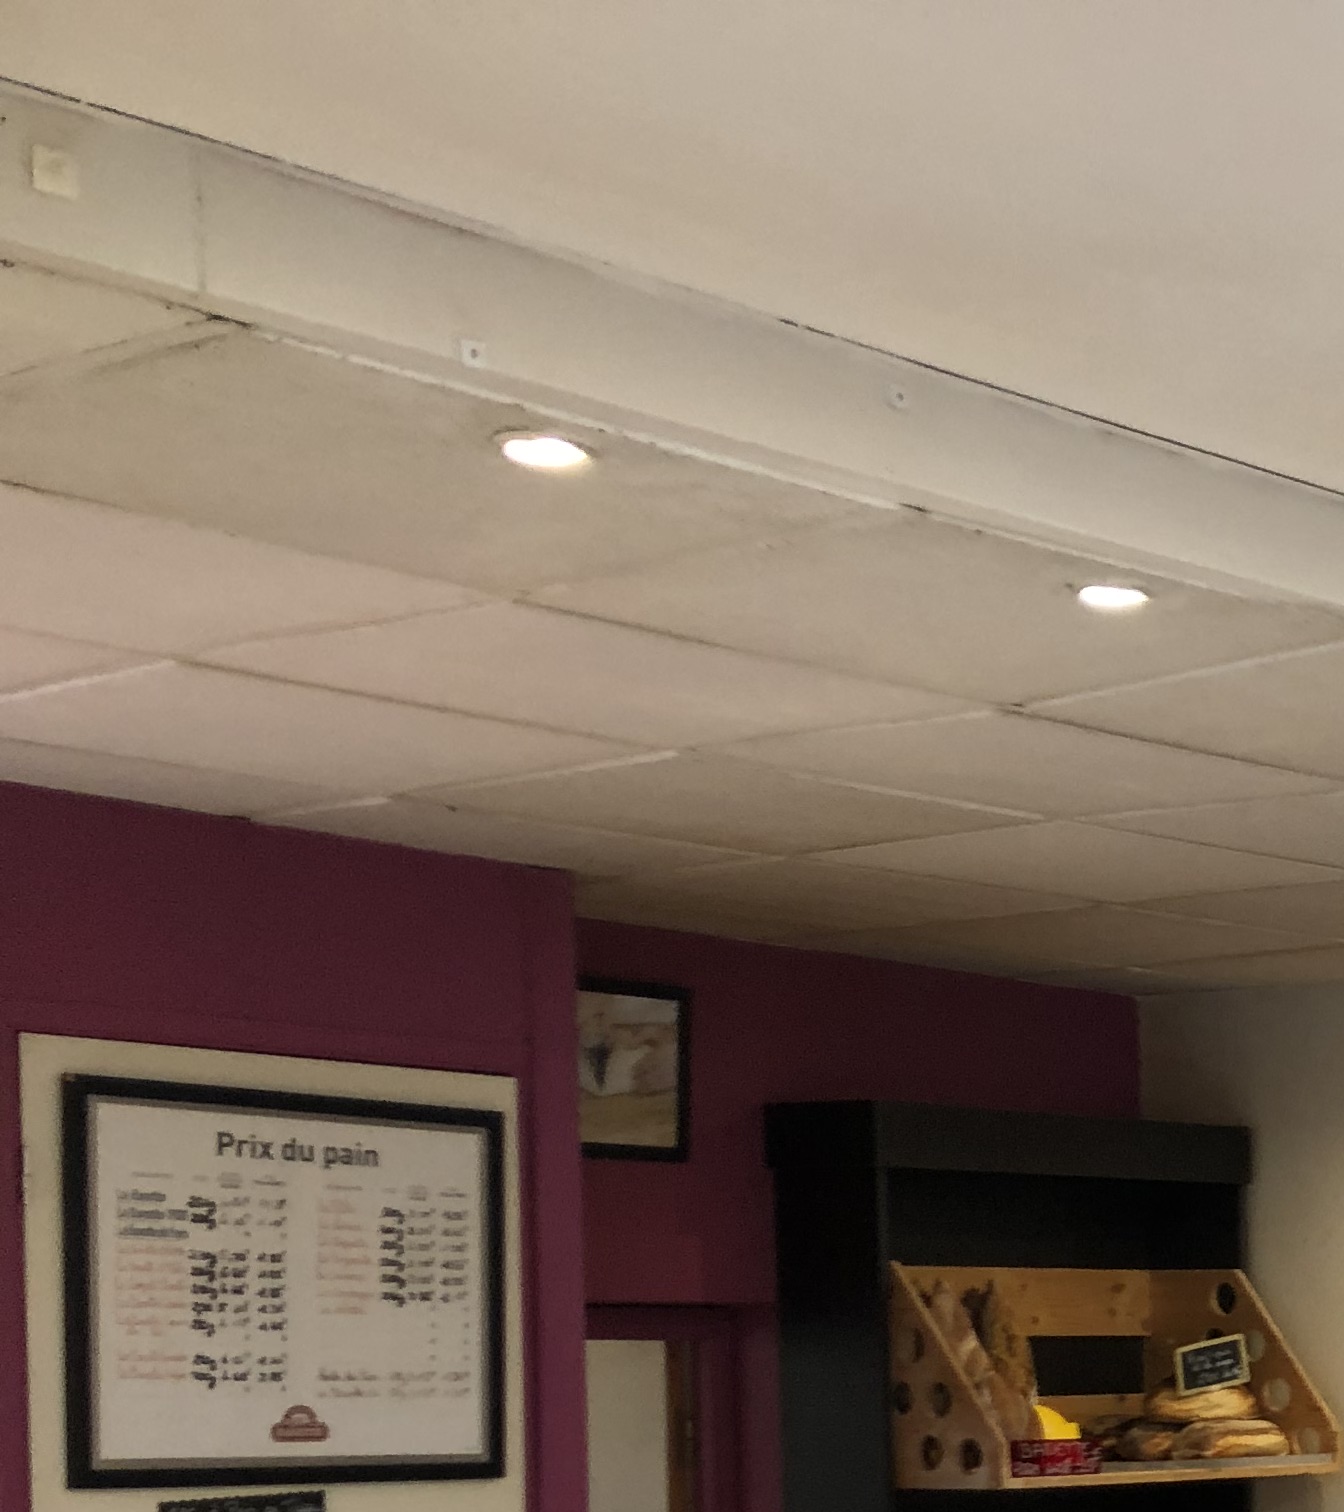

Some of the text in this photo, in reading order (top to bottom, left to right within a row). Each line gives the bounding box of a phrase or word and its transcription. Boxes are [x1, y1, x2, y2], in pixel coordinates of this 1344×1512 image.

[216, 1132, 380, 1170] Prix du pain
